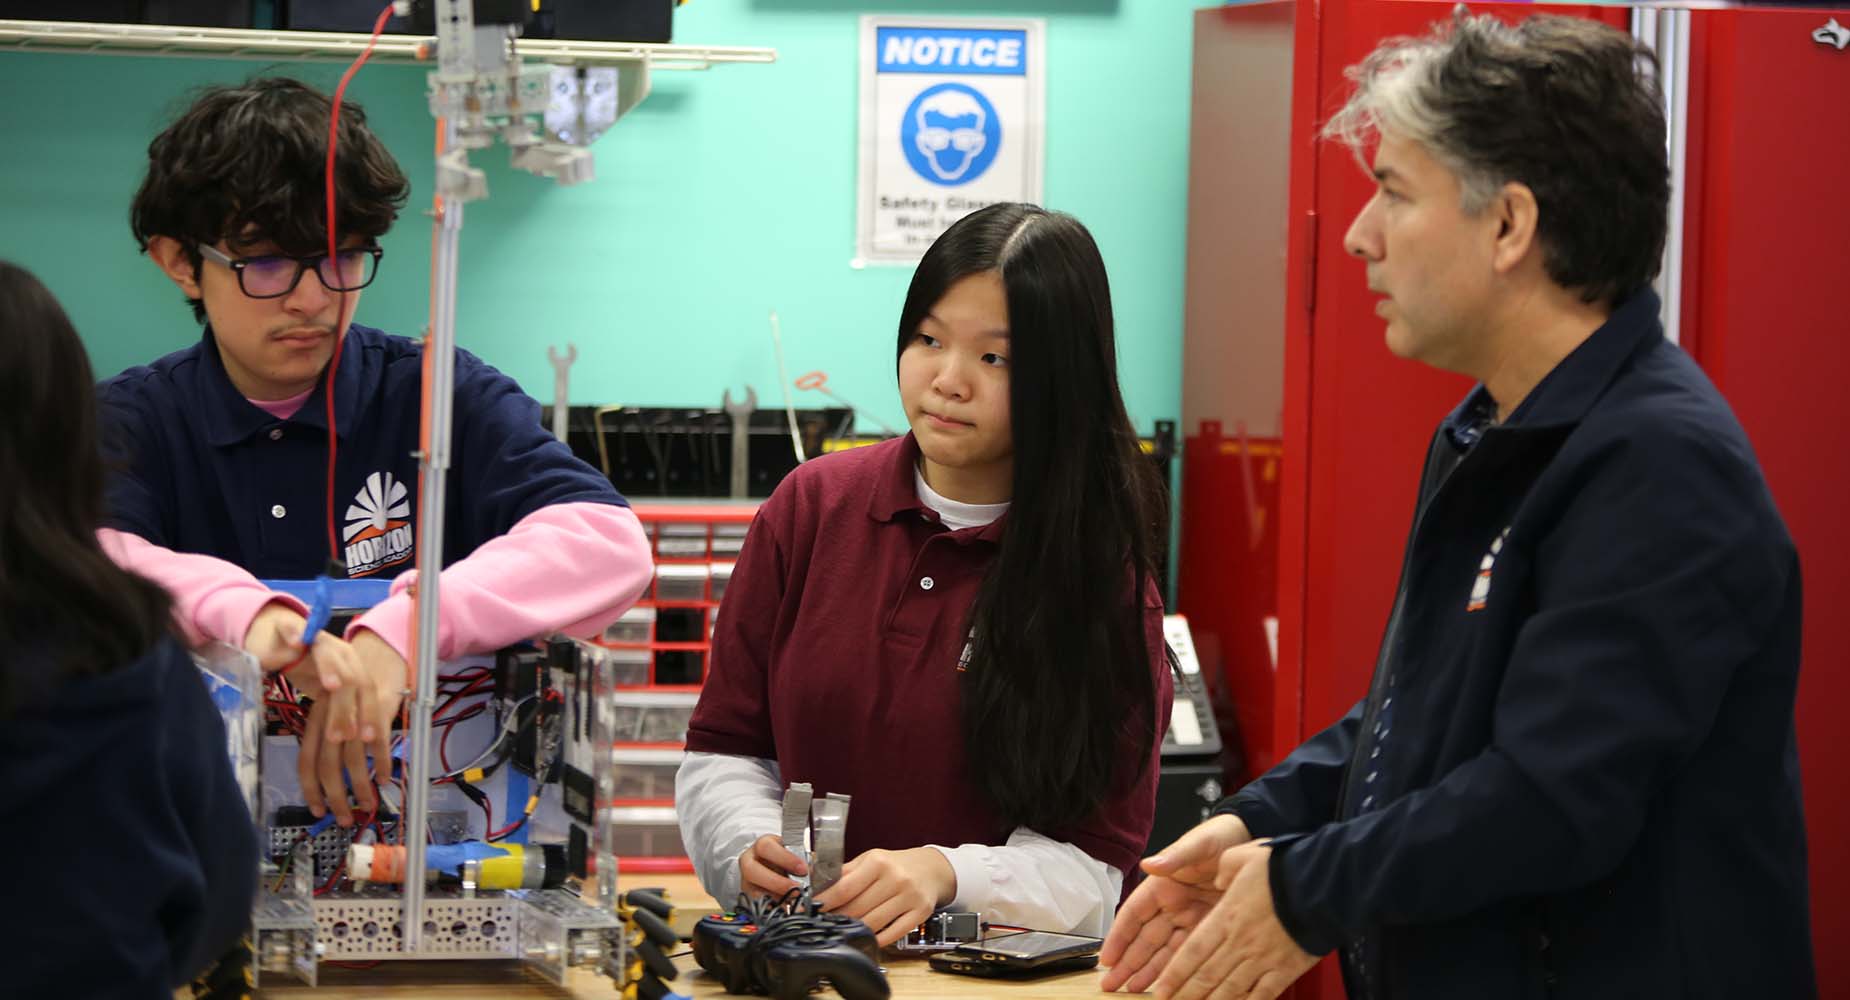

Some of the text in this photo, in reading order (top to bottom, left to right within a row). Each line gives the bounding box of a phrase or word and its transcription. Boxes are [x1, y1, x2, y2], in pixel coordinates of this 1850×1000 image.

[884, 37, 1021, 67] NOTICE
[880, 197, 996, 212] Safety Glas
[345, 523, 413, 568] HORIZON
